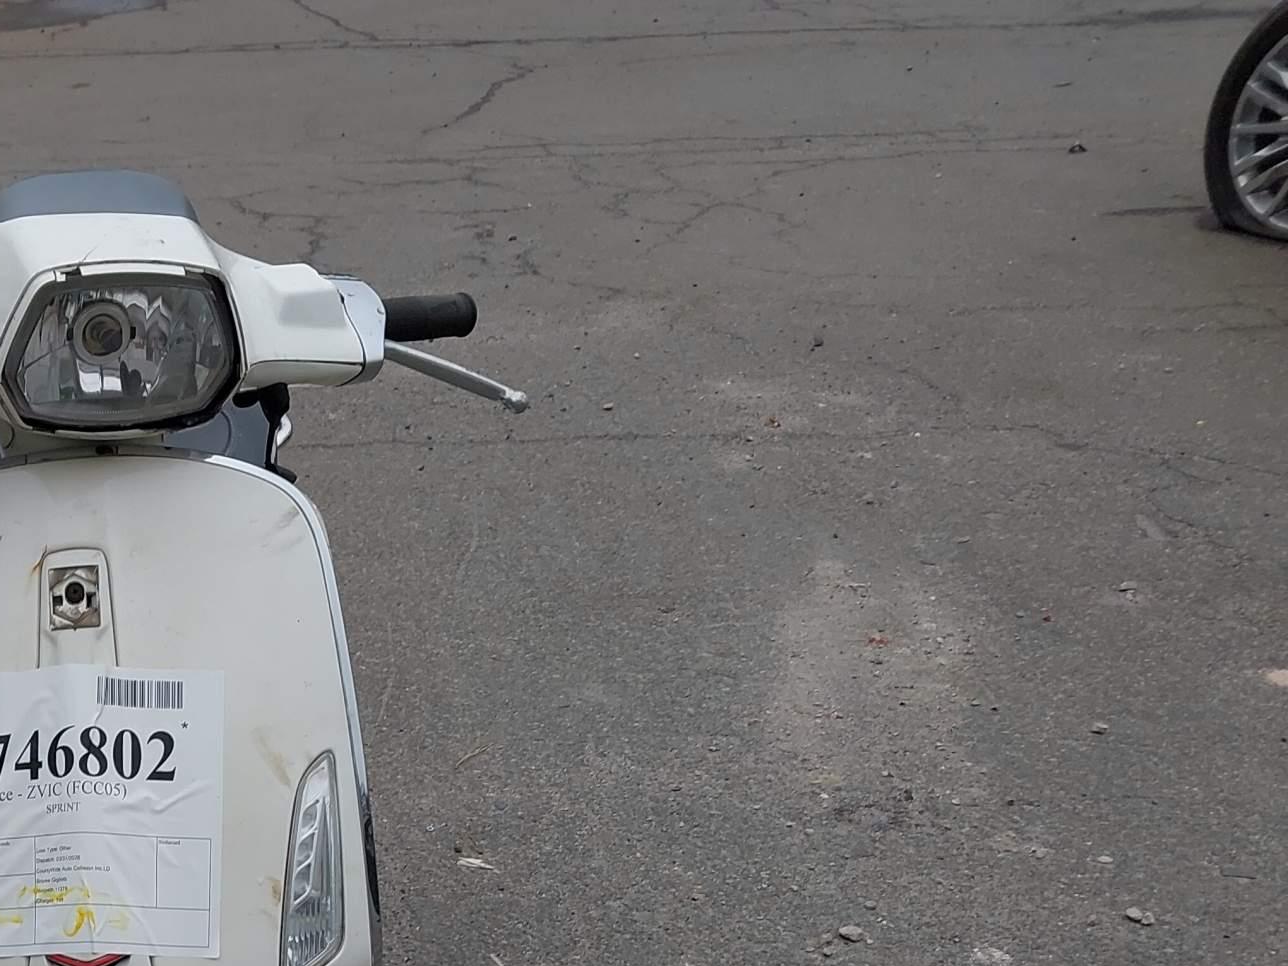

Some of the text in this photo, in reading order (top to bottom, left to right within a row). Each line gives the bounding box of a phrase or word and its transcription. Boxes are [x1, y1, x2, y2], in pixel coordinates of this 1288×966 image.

[26, 782, 62, 800] ZVIC
[66, 780, 127, 800] (FCC05)
[46, 801, 81, 814] SPRINT
